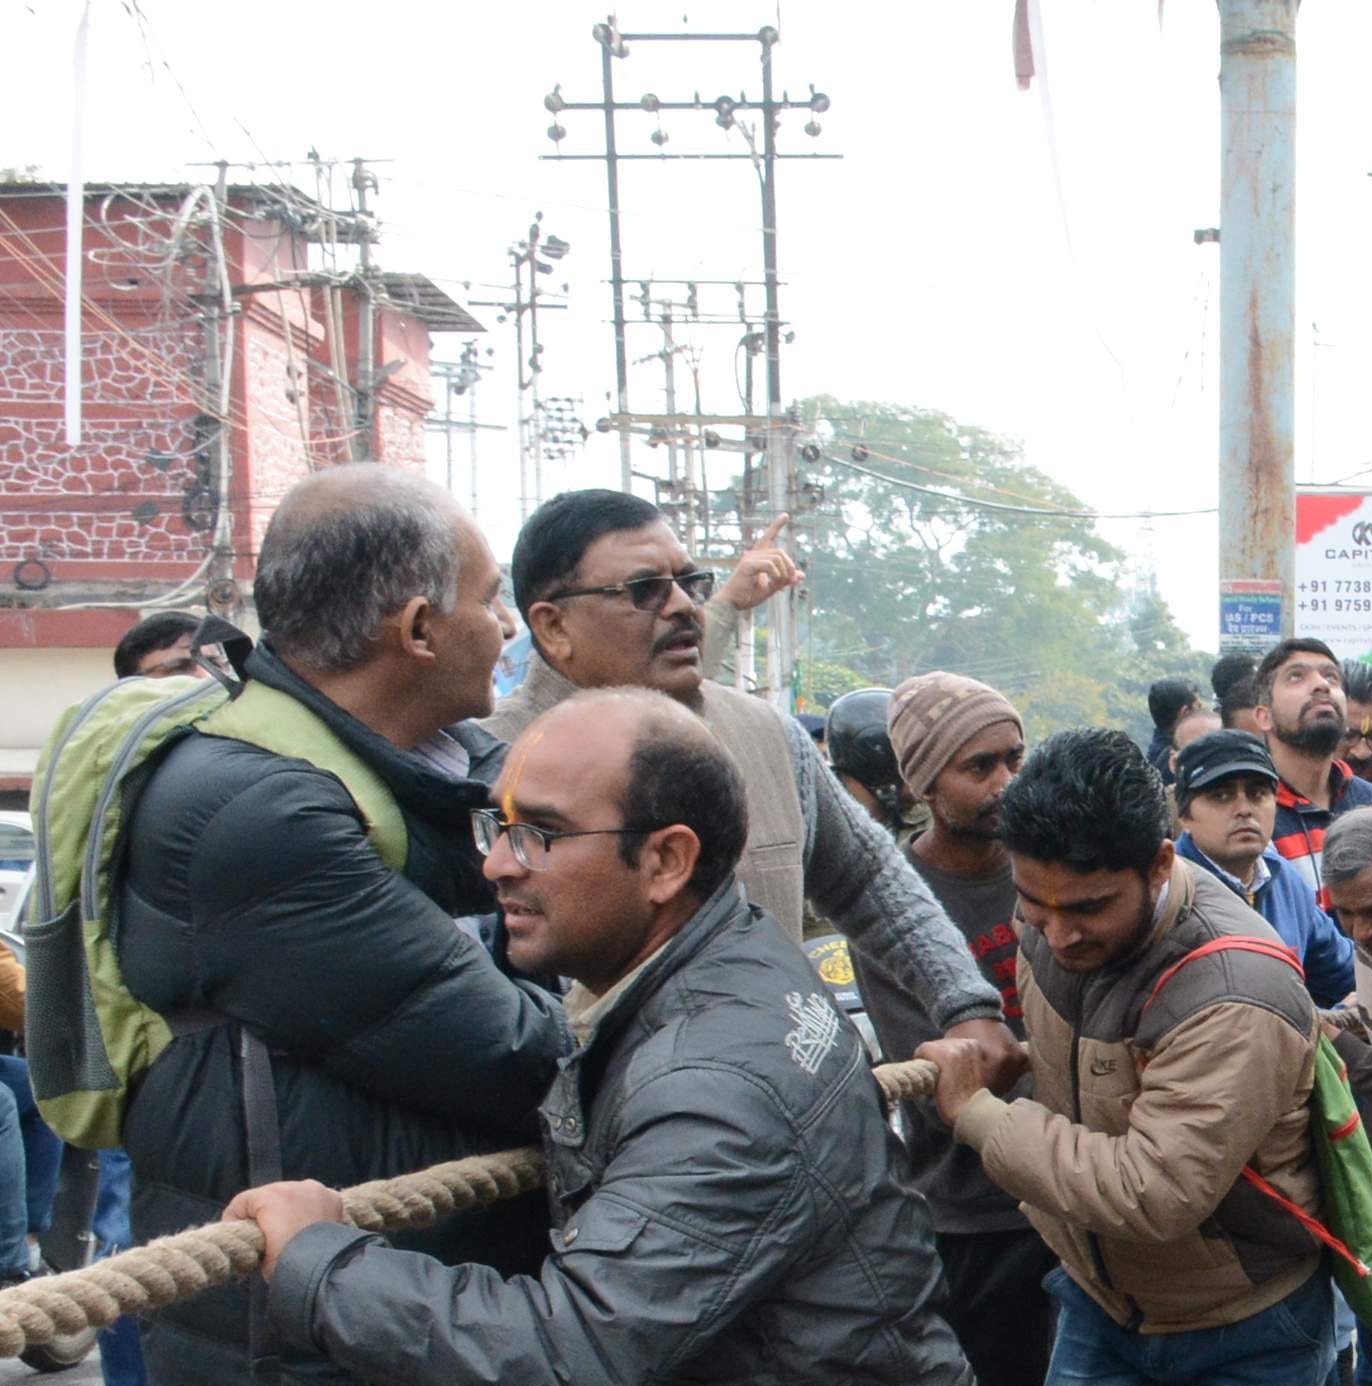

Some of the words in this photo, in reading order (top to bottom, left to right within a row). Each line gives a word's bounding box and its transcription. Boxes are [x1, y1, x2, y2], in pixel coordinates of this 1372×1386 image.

[1298, 580, 1327, 593] +91
[1298, 599, 1327, 612] +91
[1225, 613, 1241, 622] IAS
[1250, 613, 1274, 623] PCS
